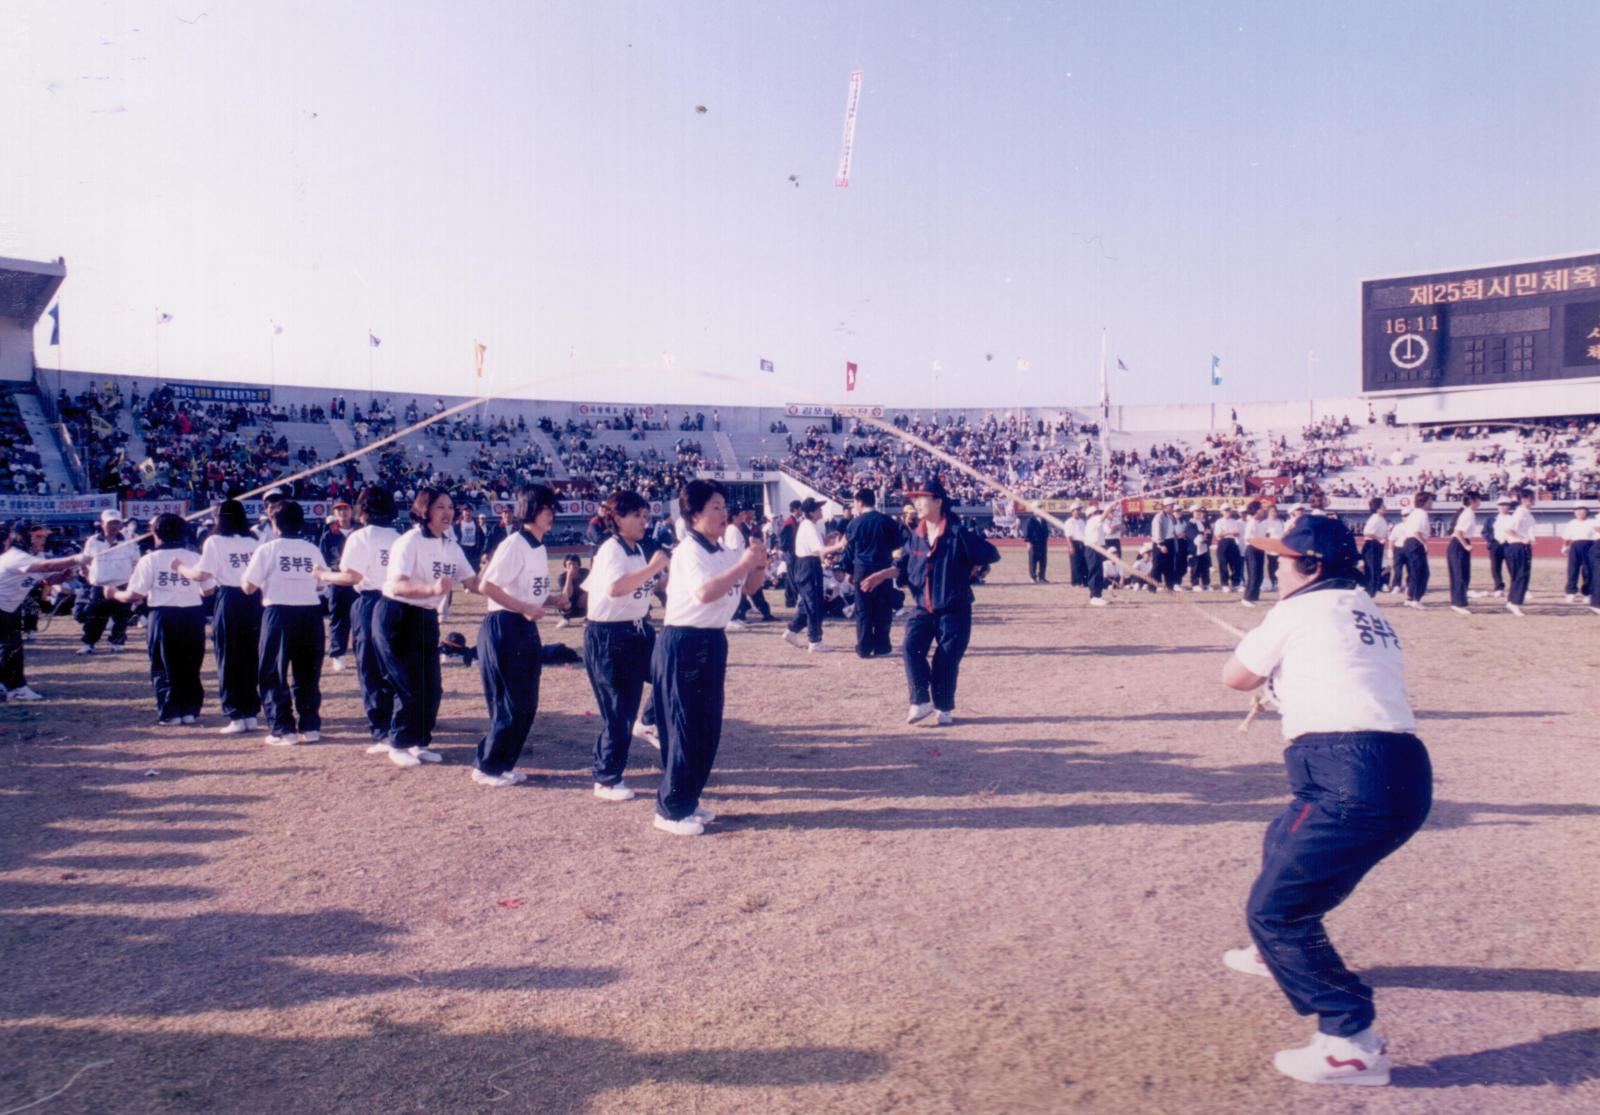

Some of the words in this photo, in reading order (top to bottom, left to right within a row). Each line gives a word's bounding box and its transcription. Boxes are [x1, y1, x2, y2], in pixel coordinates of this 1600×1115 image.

[1385, 315, 1439, 334] 16:11
[229, 552, 254, 568] 중부
[279, 556, 313, 573] 중부동
